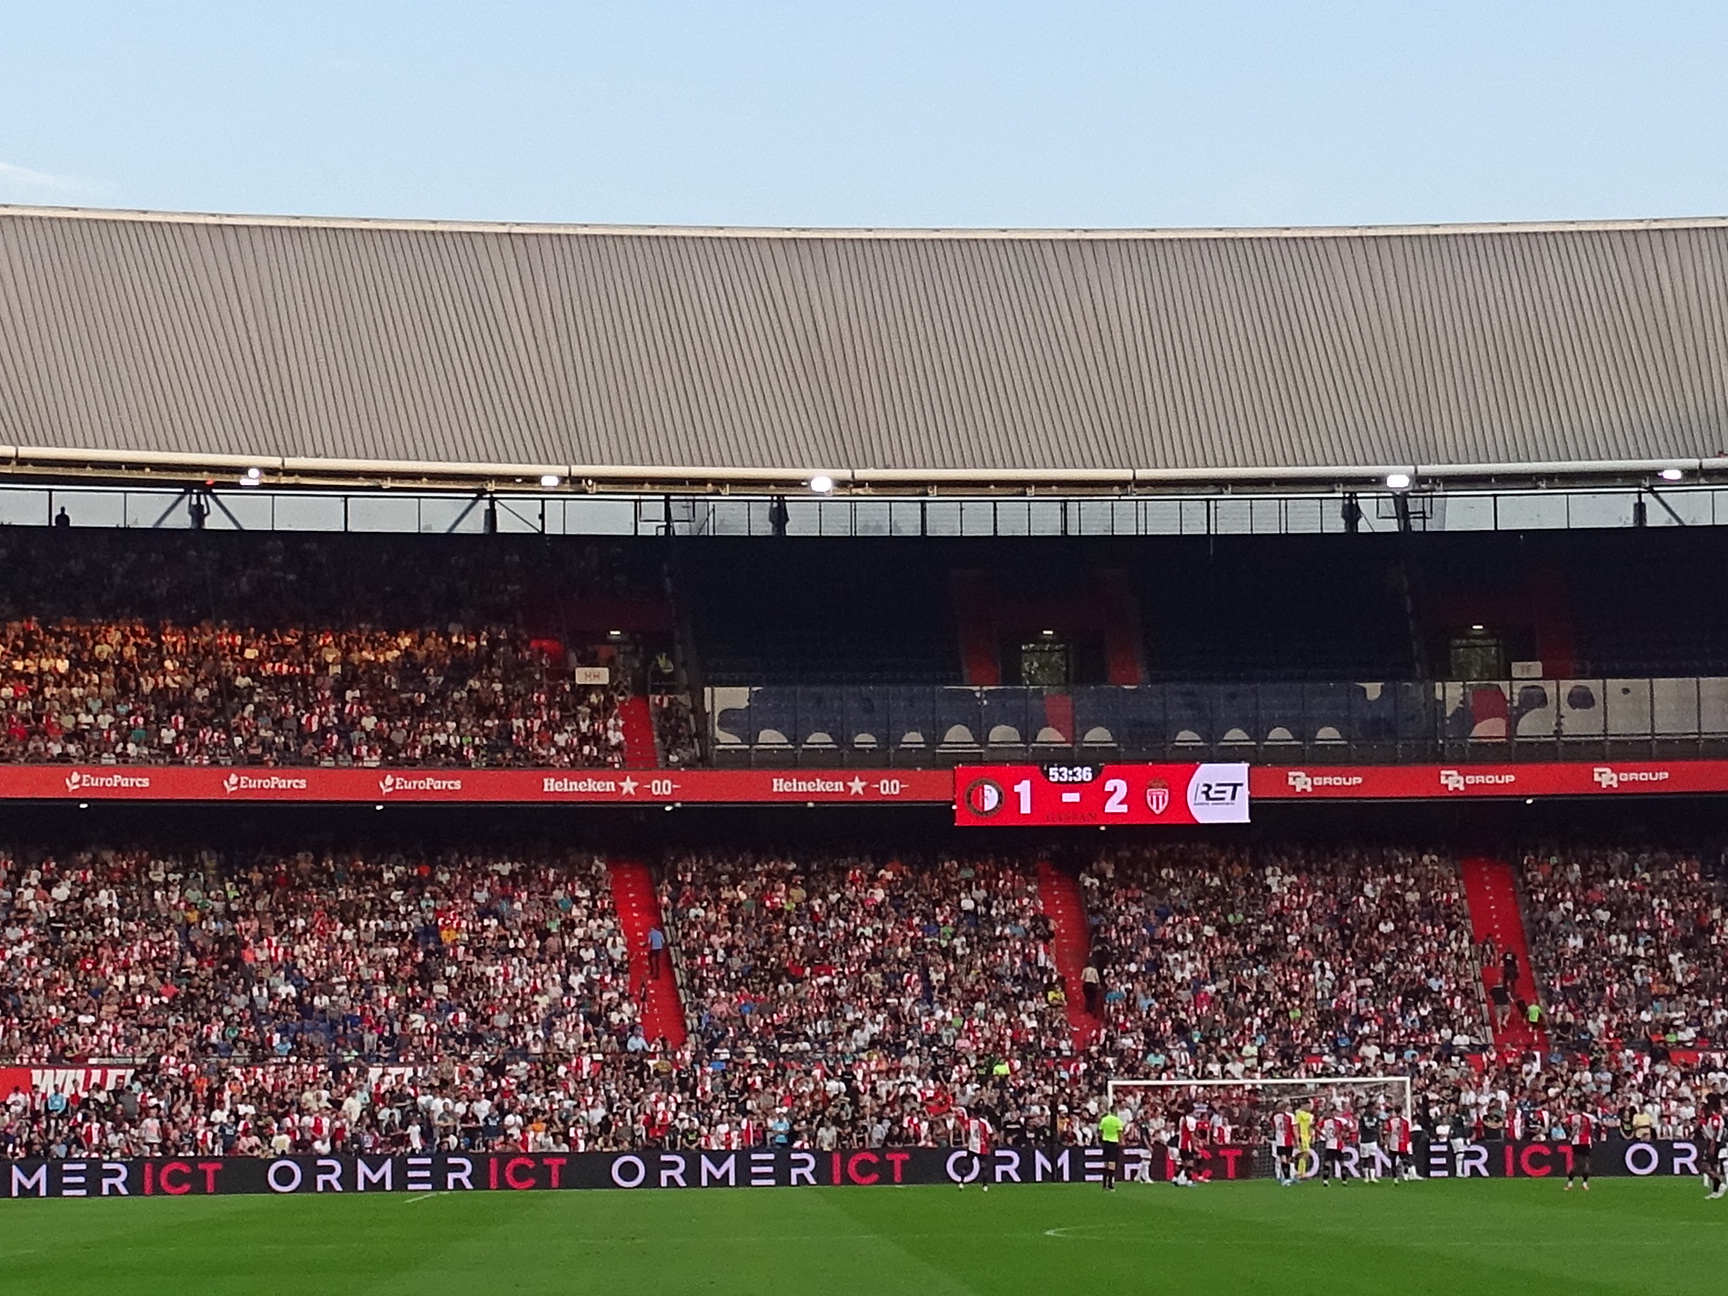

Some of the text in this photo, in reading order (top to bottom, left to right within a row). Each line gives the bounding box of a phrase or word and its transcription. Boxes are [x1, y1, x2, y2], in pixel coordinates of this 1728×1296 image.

[1048, 766, 1093, 782] 53:36
[1465, 774, 1515, 784] GROUP
[1619, 772, 1669, 782] GROUP
[81, 775, 150, 788] EuroParcs
[239, 776, 307, 789] EuroParcs
[395, 777, 461, 790] EuroParcs
[543, 778, 616, 792] Heineken
[772, 778, 845, 792] Heineken
[1313, 776, 1363, 786] GROUP
[1013, 779, 1031, 814] 1
[1104, 778, 1128, 813] 2
